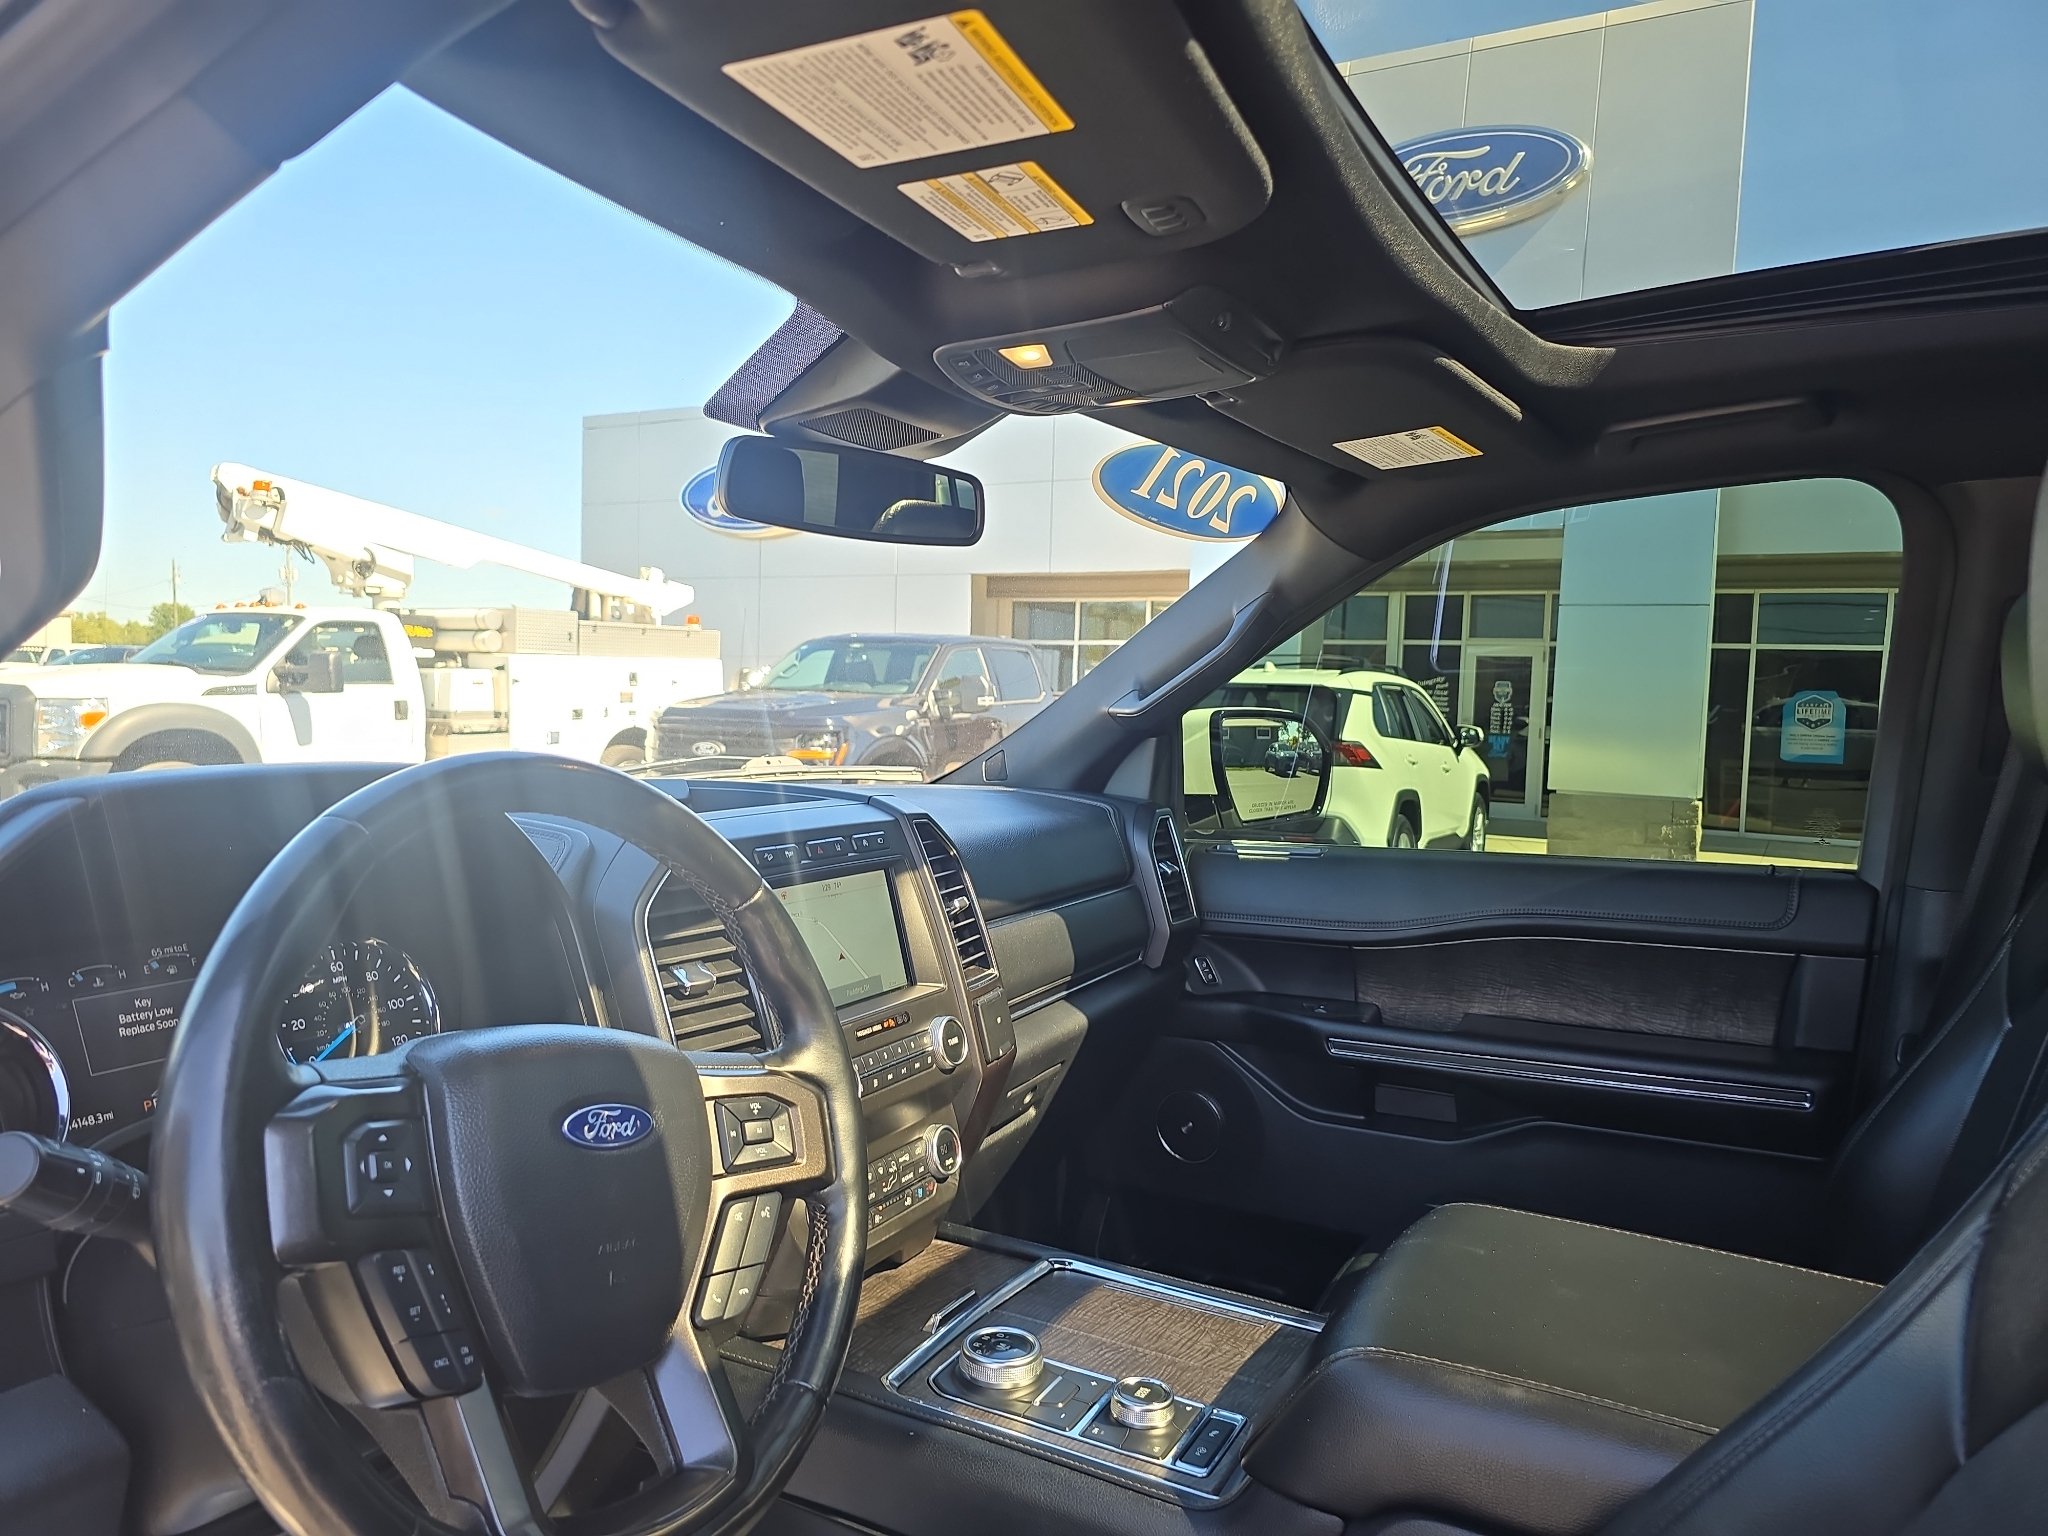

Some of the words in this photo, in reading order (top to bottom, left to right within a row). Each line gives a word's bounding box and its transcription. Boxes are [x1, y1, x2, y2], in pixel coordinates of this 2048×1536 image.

[151, 947, 162, 957] 65
[164, 946, 174, 955] mi
[174, 945, 182, 953] to
[191, 958, 197, 967] F
[330, 961, 344, 973] 60
[118, 970, 127, 979] H
[143, 965, 150, 975] E
[365, 970, 379, 982] 80
[68, 977, 75, 987] C
[332, 975, 348, 984] MPH
[41, 982, 49, 992] H
[134, 998, 152, 1008] Key
[387, 997, 405, 1010] 100
[119, 1010, 153, 1025] Battery
[154, 1006, 174, 1017] Low
[119, 1024, 155, 1037] Replace
[157, 1018, 180, 1030] Soon
[290, 1018, 306, 1031] 20
[391, 1034, 408, 1046] 120
[70, 1113, 103, 1129] 4148.3
[103, 1111, 114, 1121] mi
[584, 1108, 637, 1142] Ford
[409, 1305, 421, 1316] SET
[461, 1346, 469, 1355] ON
